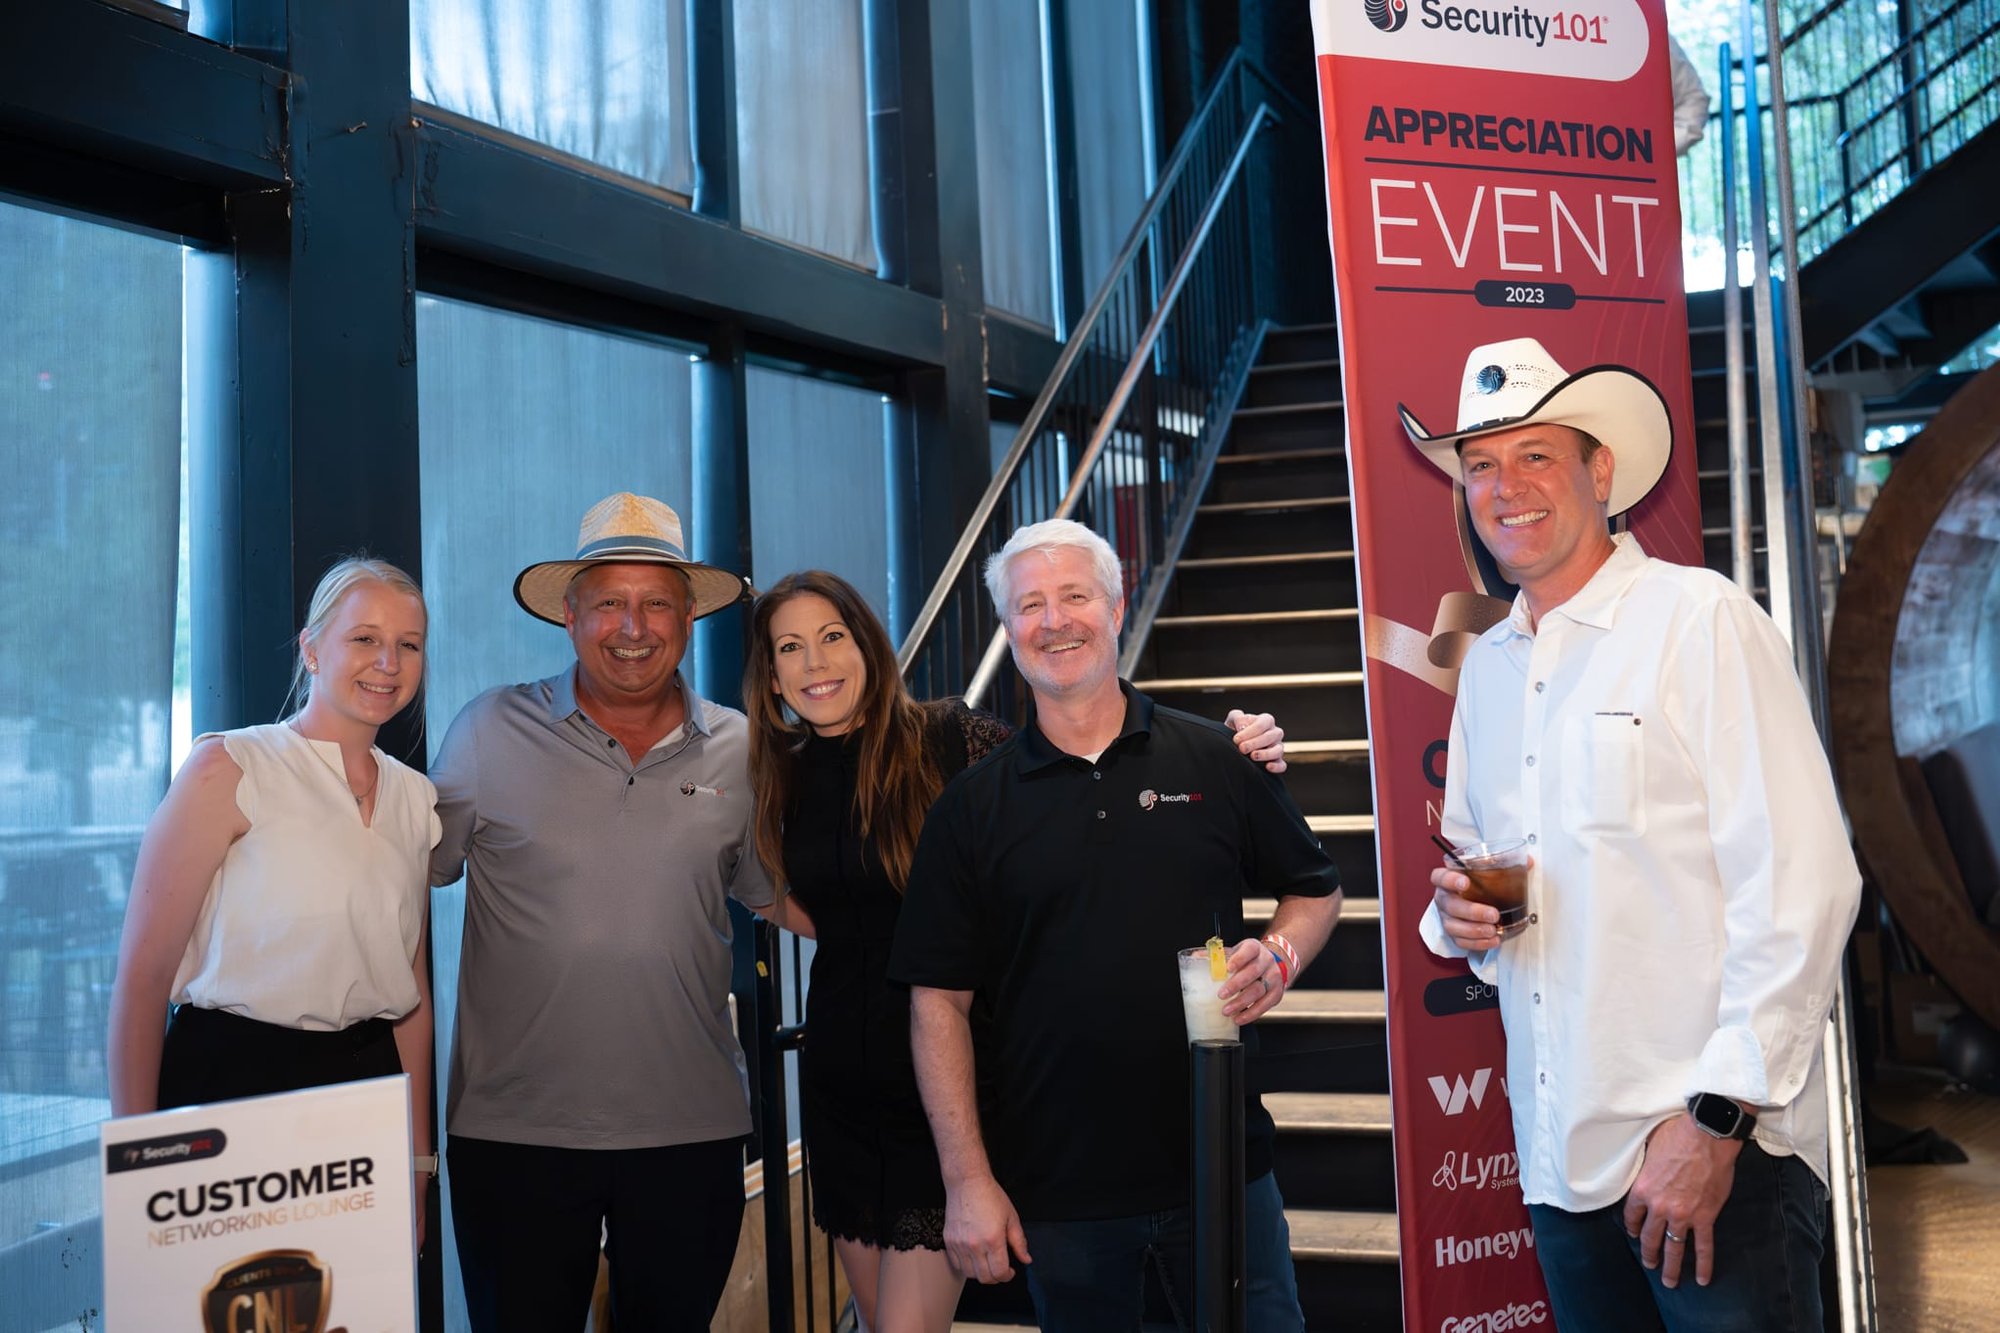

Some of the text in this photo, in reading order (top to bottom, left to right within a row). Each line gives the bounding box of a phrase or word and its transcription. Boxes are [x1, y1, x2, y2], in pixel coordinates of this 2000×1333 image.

[1364, 105, 1653, 163] APPRECIATION
[1370, 178, 1659, 278] EVENT
[1505, 286, 1545, 303] 2023
[146, 1156, 374, 1223] CUSTOMER
[1460, 1151, 1519, 1190] Lynx
[148, 1191, 375, 1247] NETWORKING LOUNGE
[226, 1285, 308, 1333] CNL
[1440, 1300, 1547, 1333] Genetec
